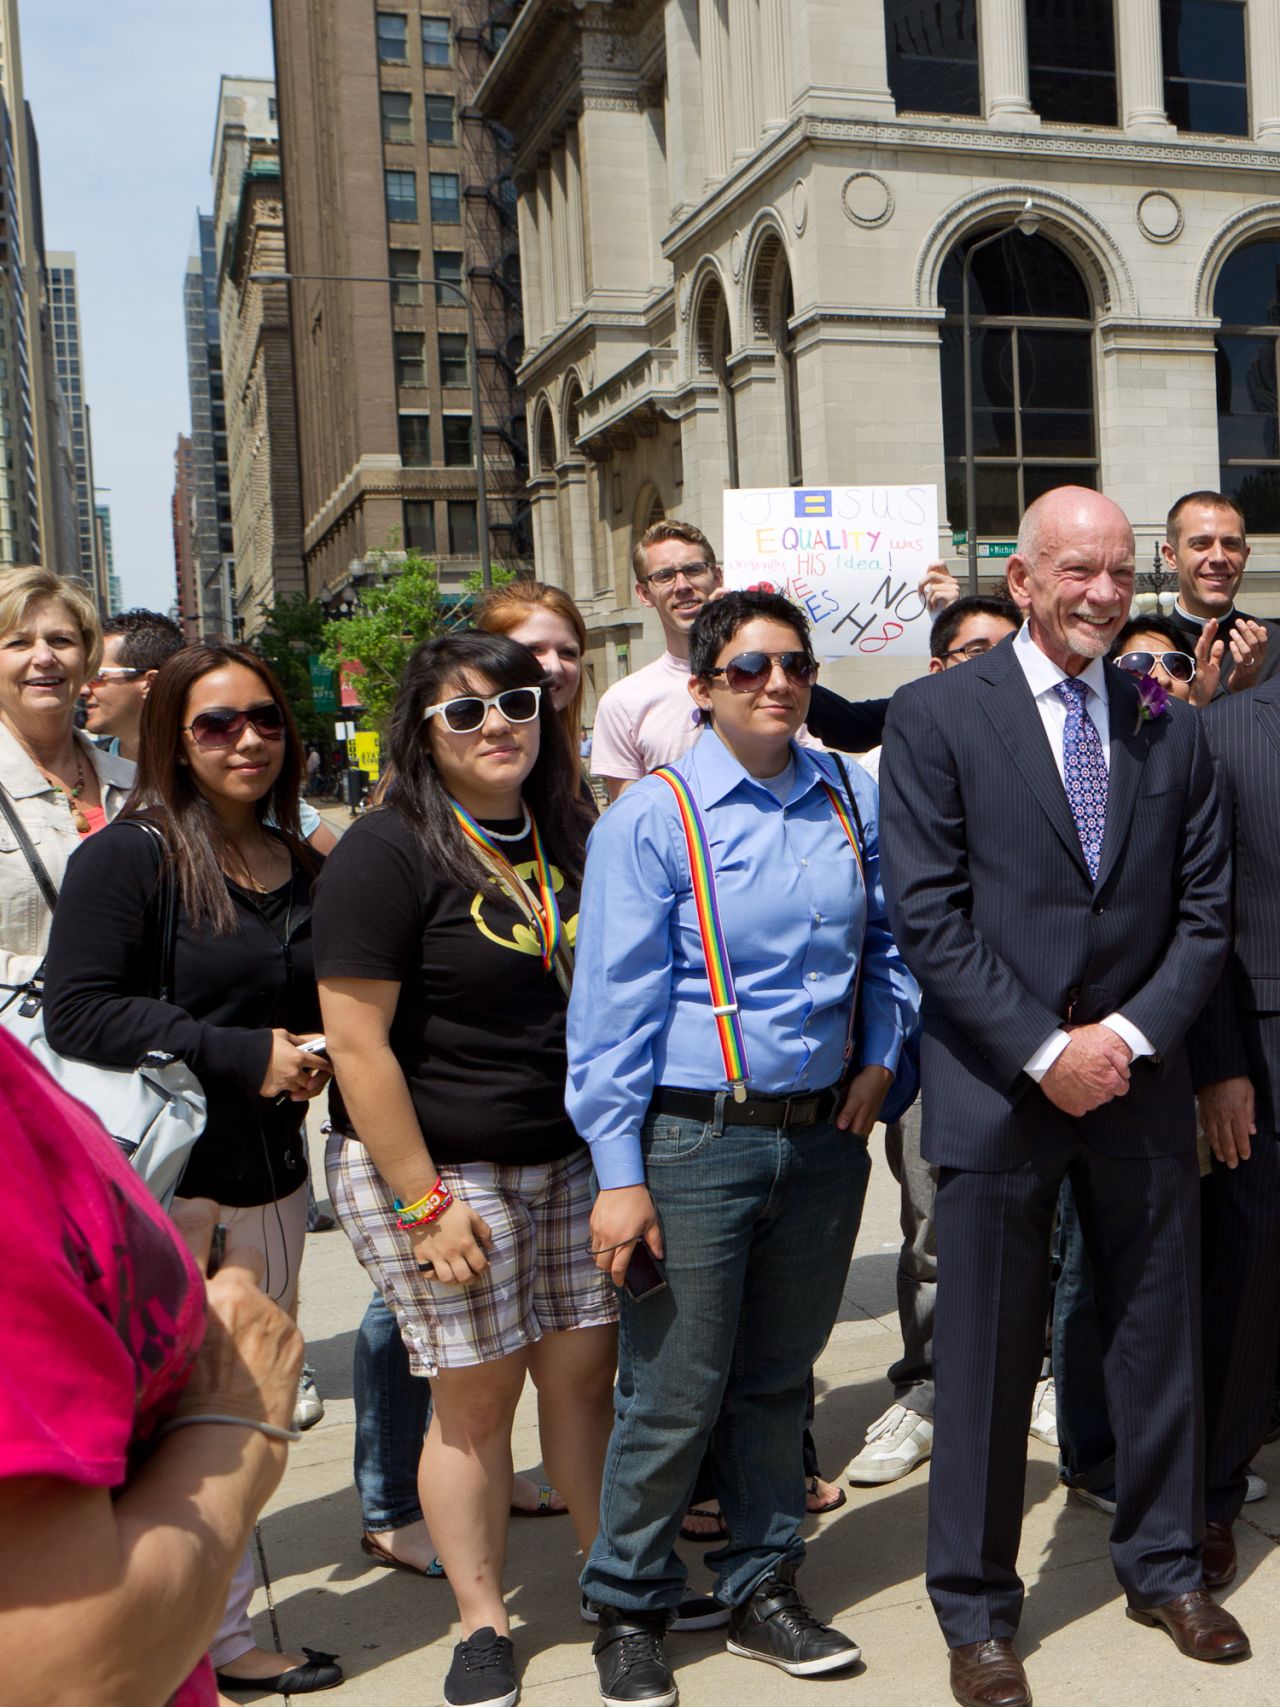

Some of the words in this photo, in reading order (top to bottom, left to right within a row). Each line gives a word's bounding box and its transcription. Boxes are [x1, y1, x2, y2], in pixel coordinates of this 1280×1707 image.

[756, 527, 881, 554] EQUALITY
[889, 538, 924, 552] was
[797, 552, 826, 576] HIS
[870, 574, 927, 622] NO
[831, 602, 904, 653] H8
